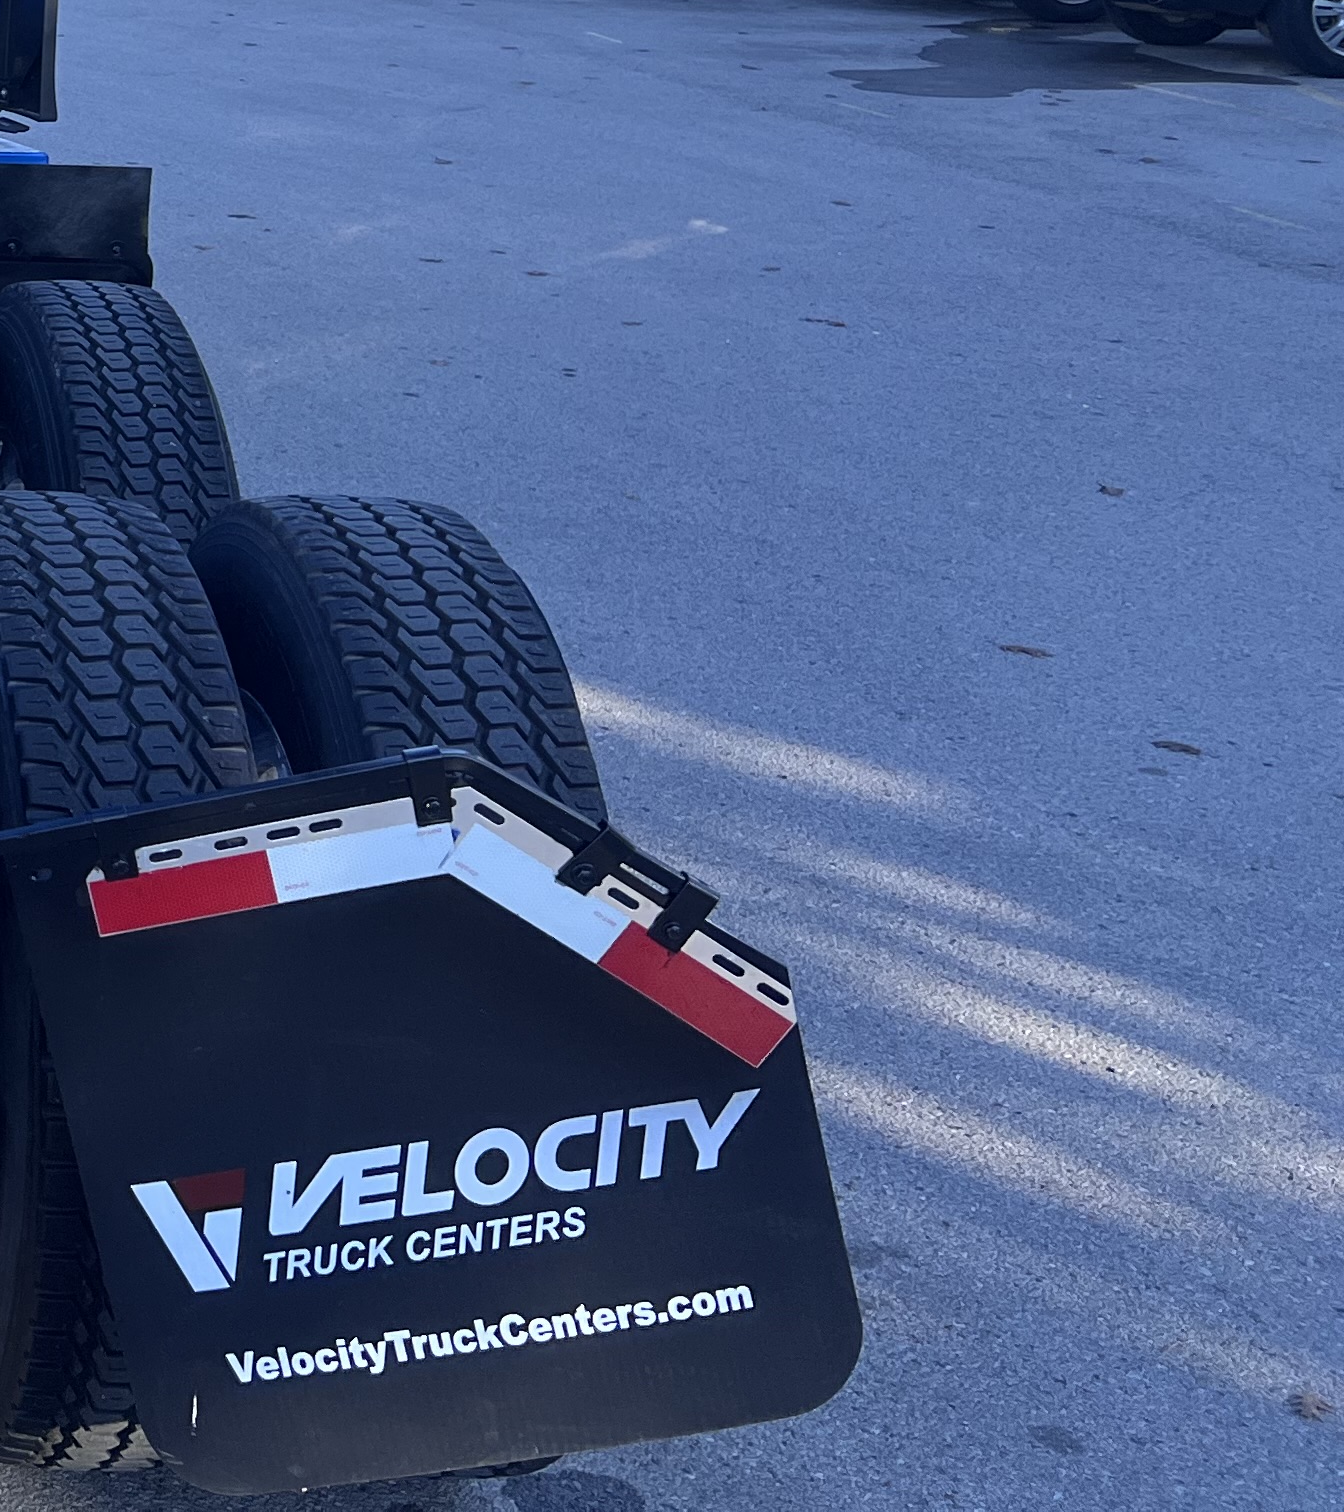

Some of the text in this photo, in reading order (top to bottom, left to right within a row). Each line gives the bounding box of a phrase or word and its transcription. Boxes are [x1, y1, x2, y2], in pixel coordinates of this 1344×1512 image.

[268, 1088, 761, 1236] VELOCITY
[263, 1206, 587, 1284] TRUCK CENTERS
[226, 1284, 754, 1384] VelocityTruckCenters.com
